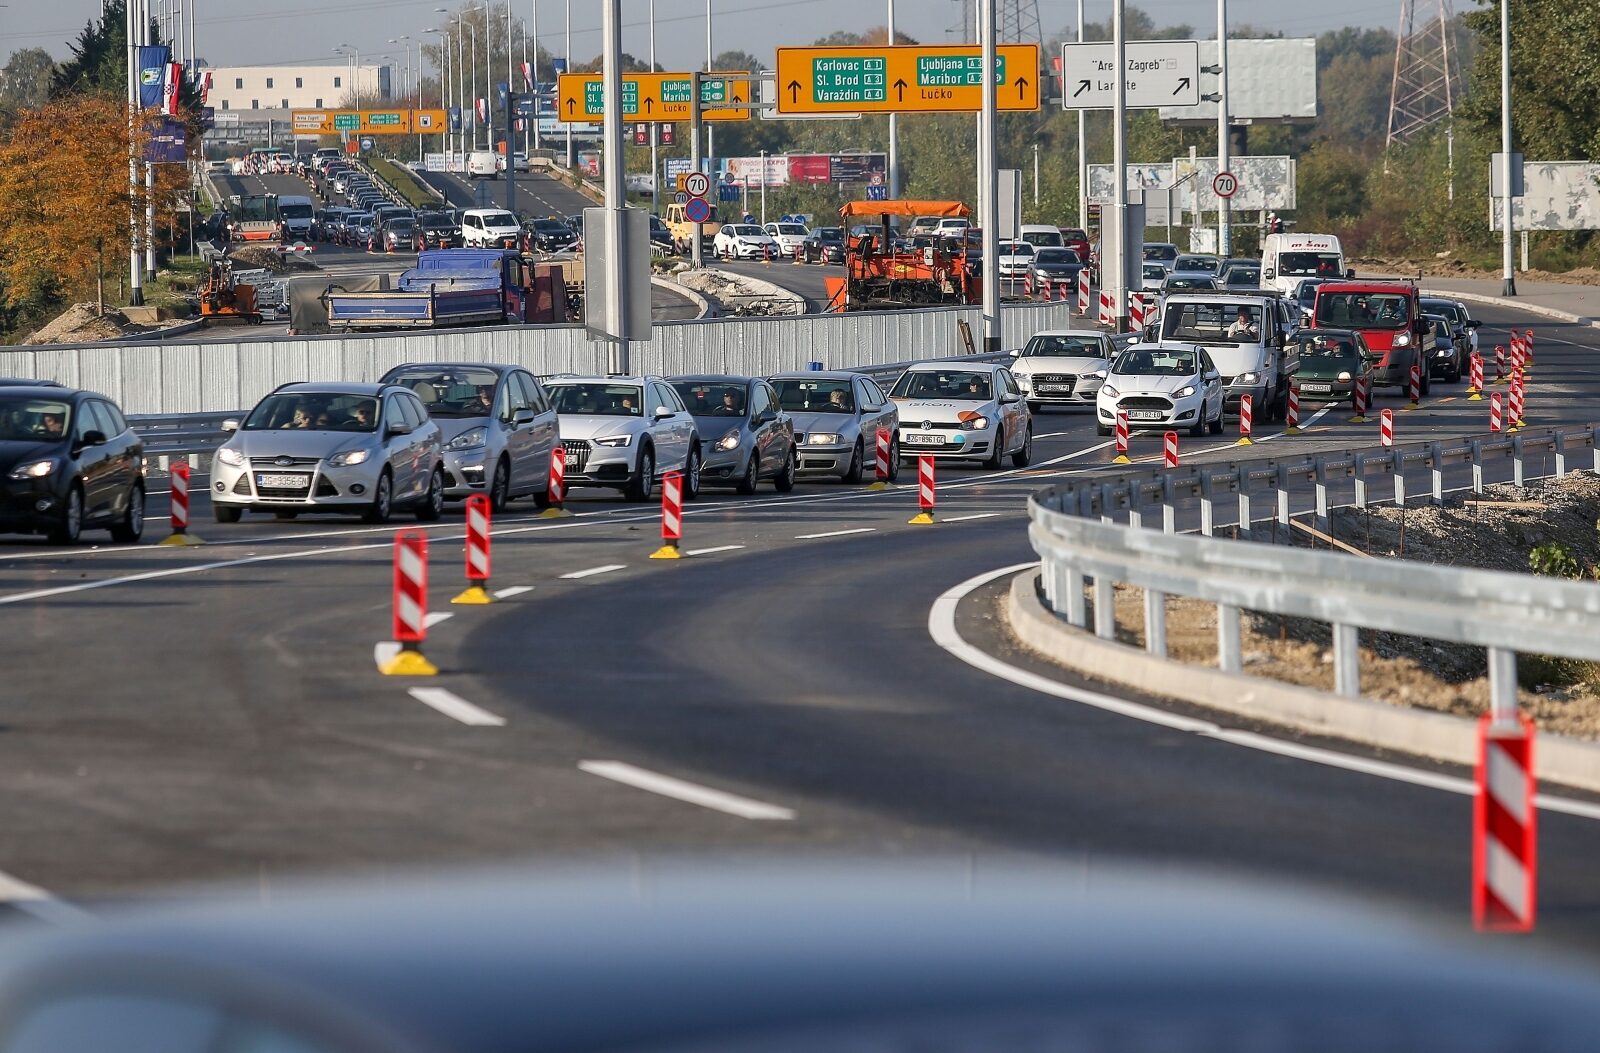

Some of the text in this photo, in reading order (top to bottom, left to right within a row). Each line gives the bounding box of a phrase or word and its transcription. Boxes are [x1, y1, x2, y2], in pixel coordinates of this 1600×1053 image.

[816, 59, 859, 71] Karlovac
[920, 58, 963, 72] Ljubljana
[816, 74, 829, 86] Sl.
[835, 74, 859, 86] Brod
[920, 73, 962, 85] Maribor
[663, 82, 690, 92] Ljubljan
[663, 93, 690, 102] Maribo
[817, 88, 860, 101] Varaždin
[921, 88, 953, 99] Lučko
[690, 179, 705, 191] 70
[1218, 178, 1233, 191] 70
